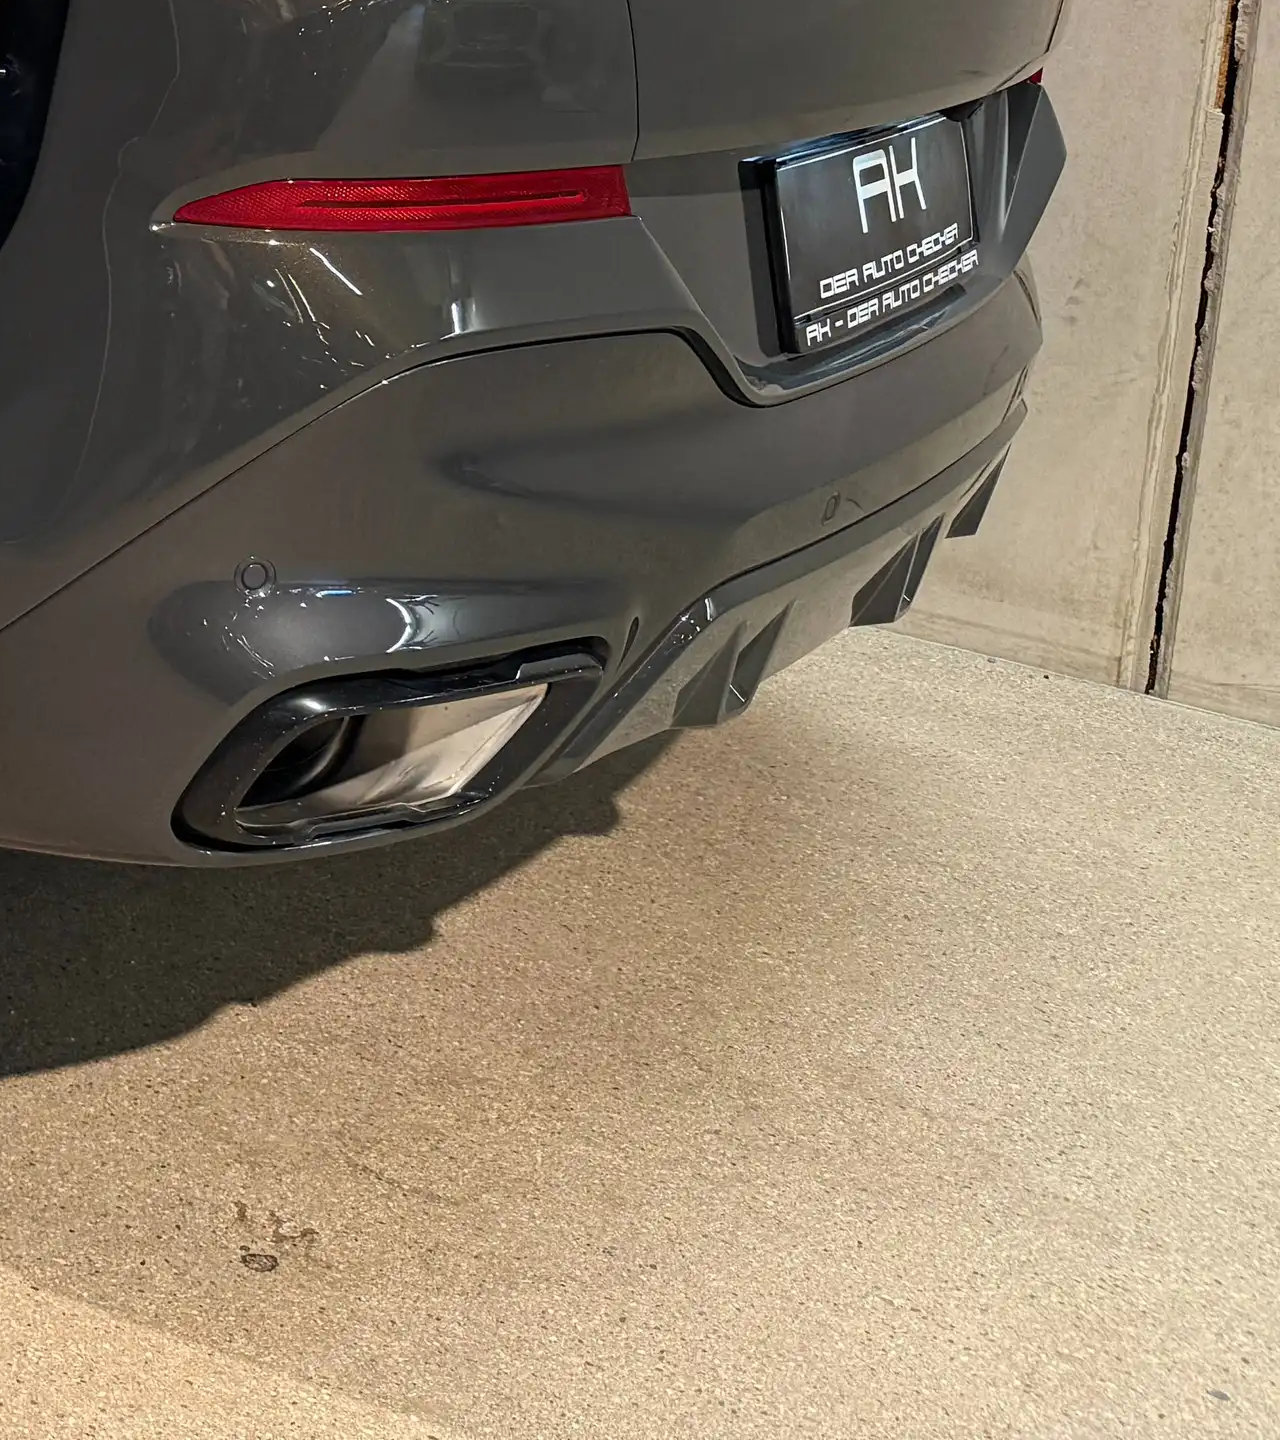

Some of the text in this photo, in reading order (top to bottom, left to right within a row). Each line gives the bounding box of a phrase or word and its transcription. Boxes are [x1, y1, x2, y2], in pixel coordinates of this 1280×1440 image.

[853, 137, 927, 234] AK
[806, 318, 831, 346] AK
[846, 297, 879, 329] DER
[882, 279, 921, 313] AUTO
[923, 249, 979, 294] CHECKER
[819, 222, 959, 299] DER AUTO CHECKER
